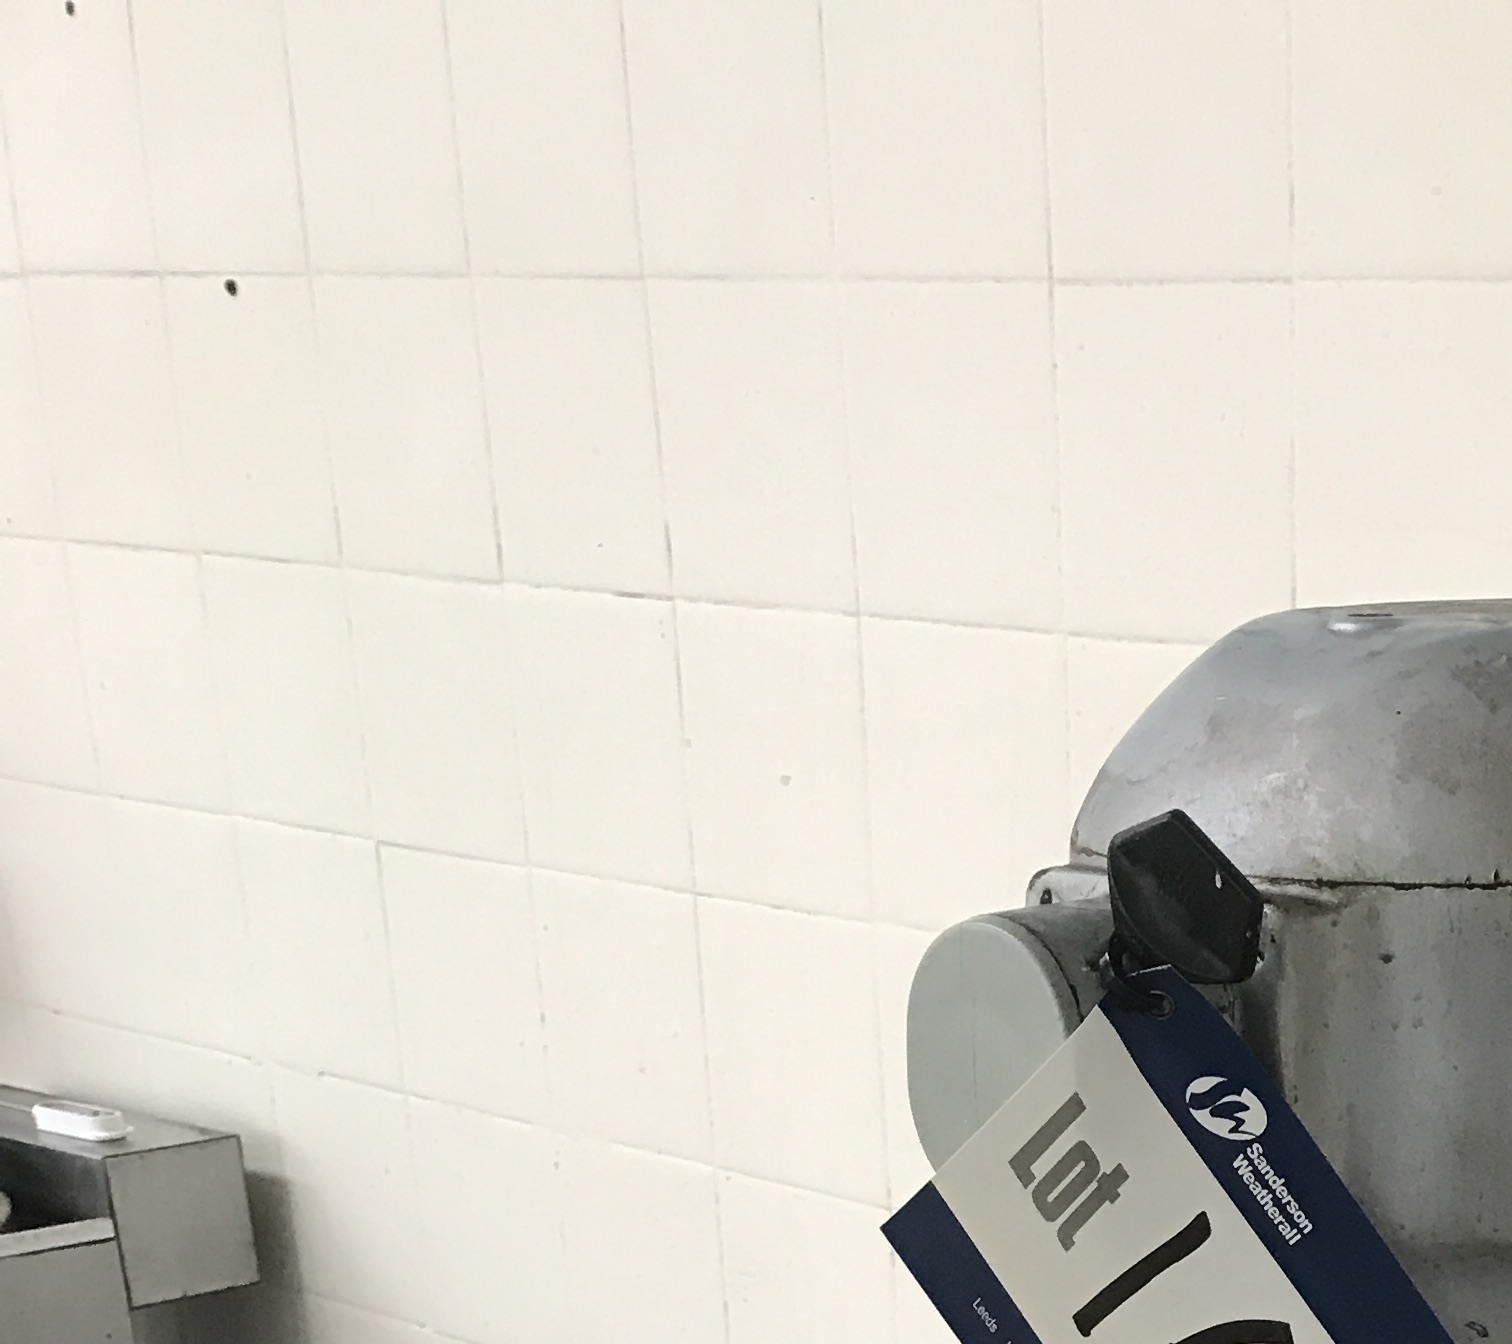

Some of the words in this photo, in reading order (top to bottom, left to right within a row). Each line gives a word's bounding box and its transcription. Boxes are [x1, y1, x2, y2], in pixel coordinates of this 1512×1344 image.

[1008, 1091, 1130, 1253] Lot
[1232, 1153, 1302, 1246] Weatherall
[1246, 1142, 1314, 1235] Sanderson
[972, 1297, 998, 1333] Leeds
